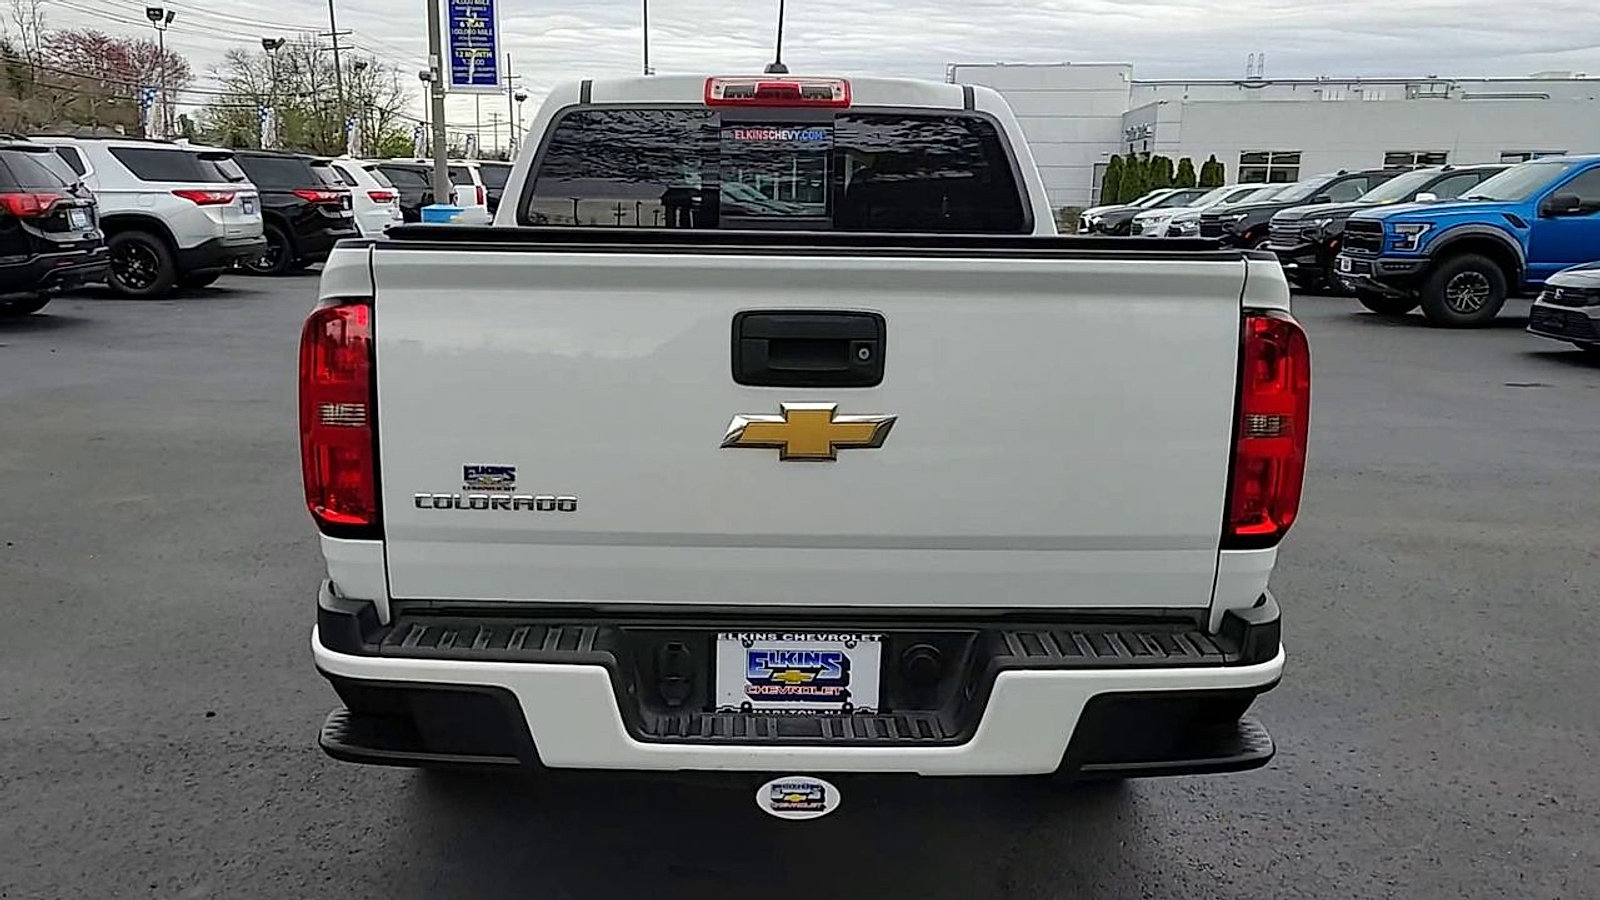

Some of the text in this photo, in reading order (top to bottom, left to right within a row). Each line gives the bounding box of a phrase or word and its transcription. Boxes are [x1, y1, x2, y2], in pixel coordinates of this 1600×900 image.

[734, 129, 824, 140] ELKINSCHEVY.COM
[414, 493, 578, 512] COLORADO
[717, 633, 882, 642] ELKINS CHEVROLET
[747, 650, 843, 679] ELKINS
[745, 685, 844, 696] CHEVROLET
